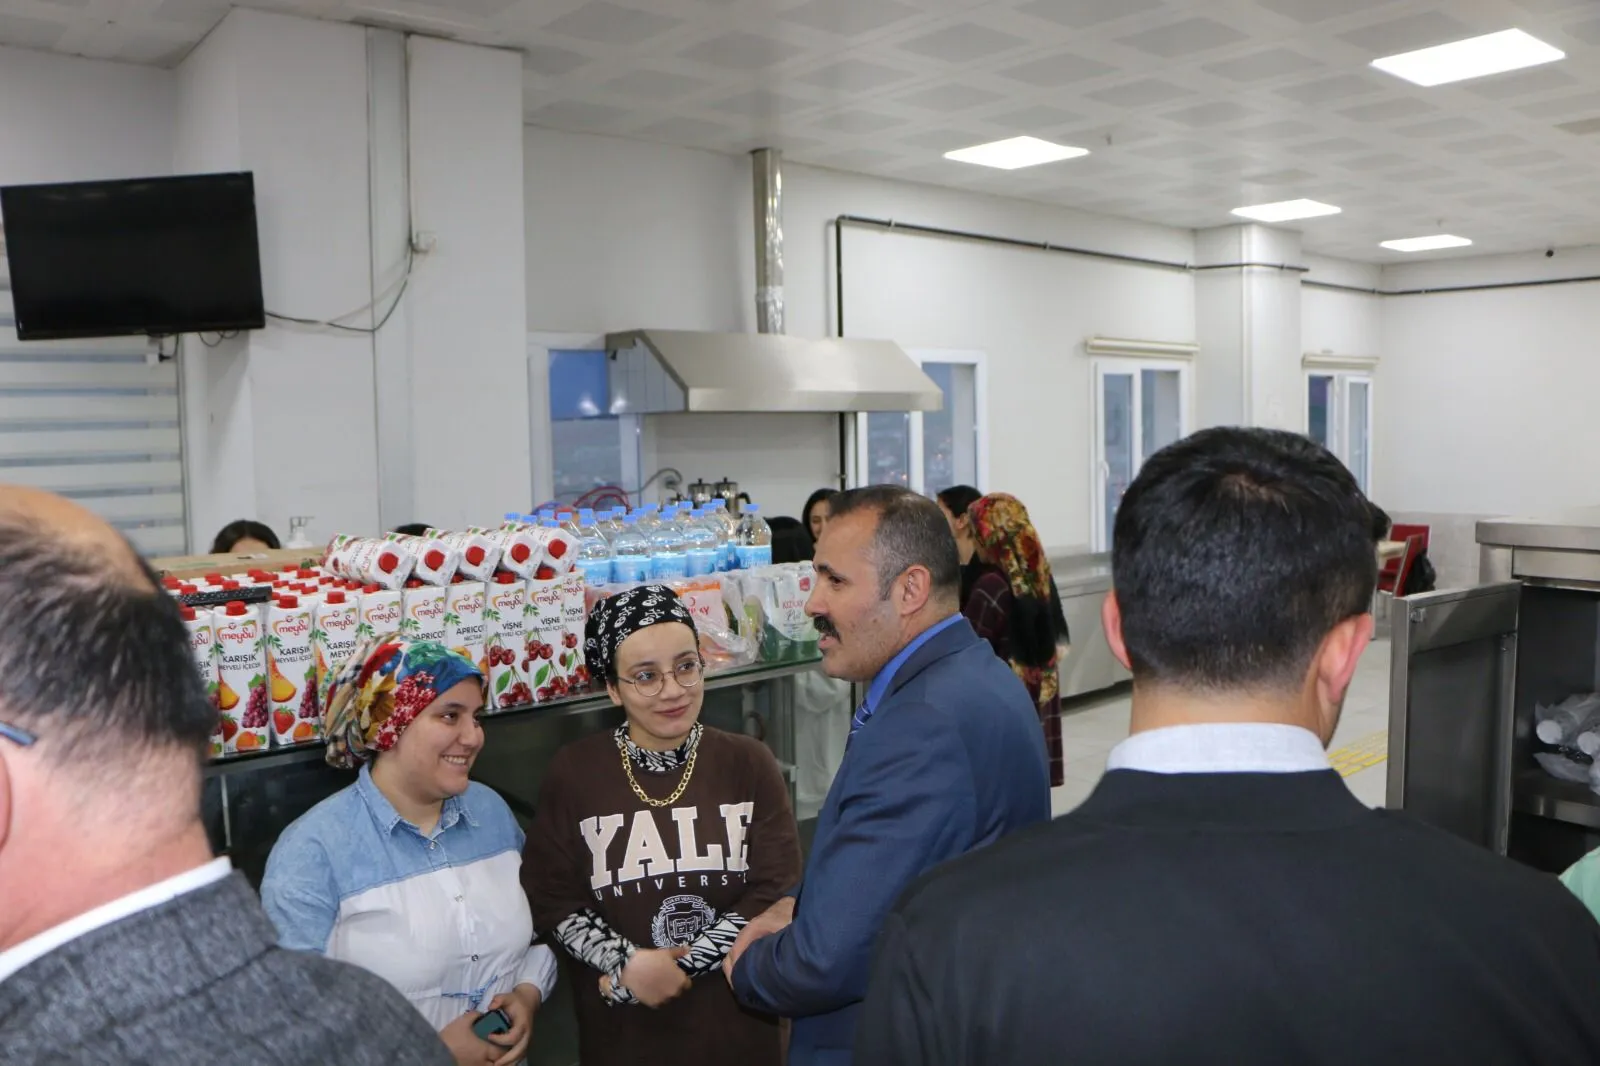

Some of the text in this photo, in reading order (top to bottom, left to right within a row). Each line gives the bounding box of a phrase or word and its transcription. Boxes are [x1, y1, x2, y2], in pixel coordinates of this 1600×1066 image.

[458, 599, 484, 613] meys
[221, 627, 255, 643] meysu
[279, 620, 309, 636] meysu
[191, 633, 209, 650] ysu
[222, 653, 257, 666] KARIŞIK
[579, 801, 754, 890] YALE
